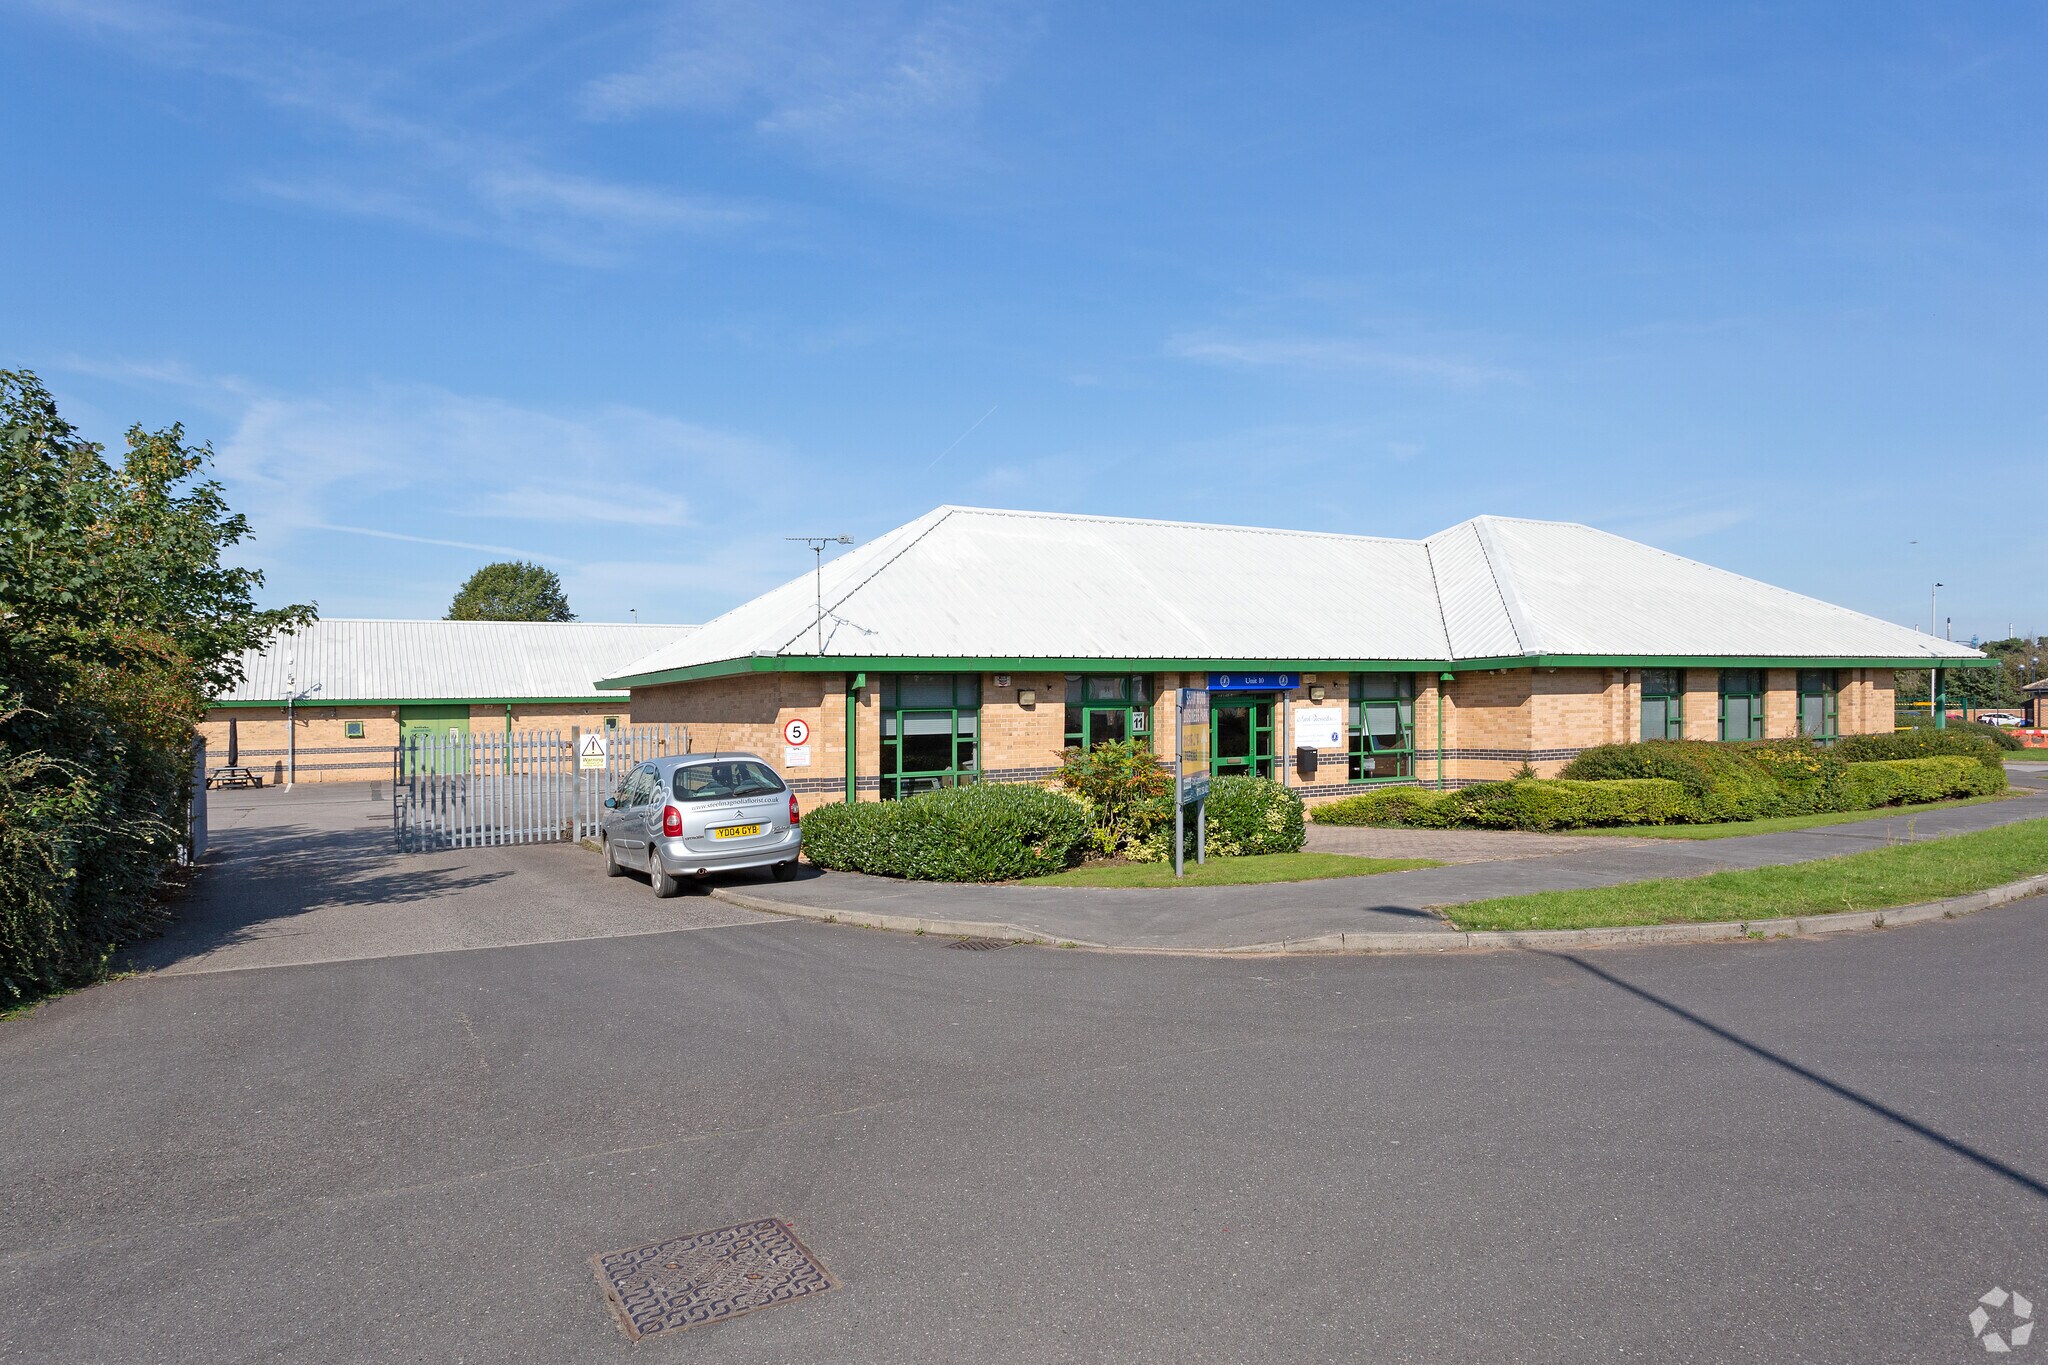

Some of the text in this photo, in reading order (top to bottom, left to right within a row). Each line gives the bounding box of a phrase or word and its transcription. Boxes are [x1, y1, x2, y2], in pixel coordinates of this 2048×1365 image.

[1133, 717, 1143, 729] 11
[792, 725, 802, 739] 5
[718, 825, 758, 837] YD04 GYB
